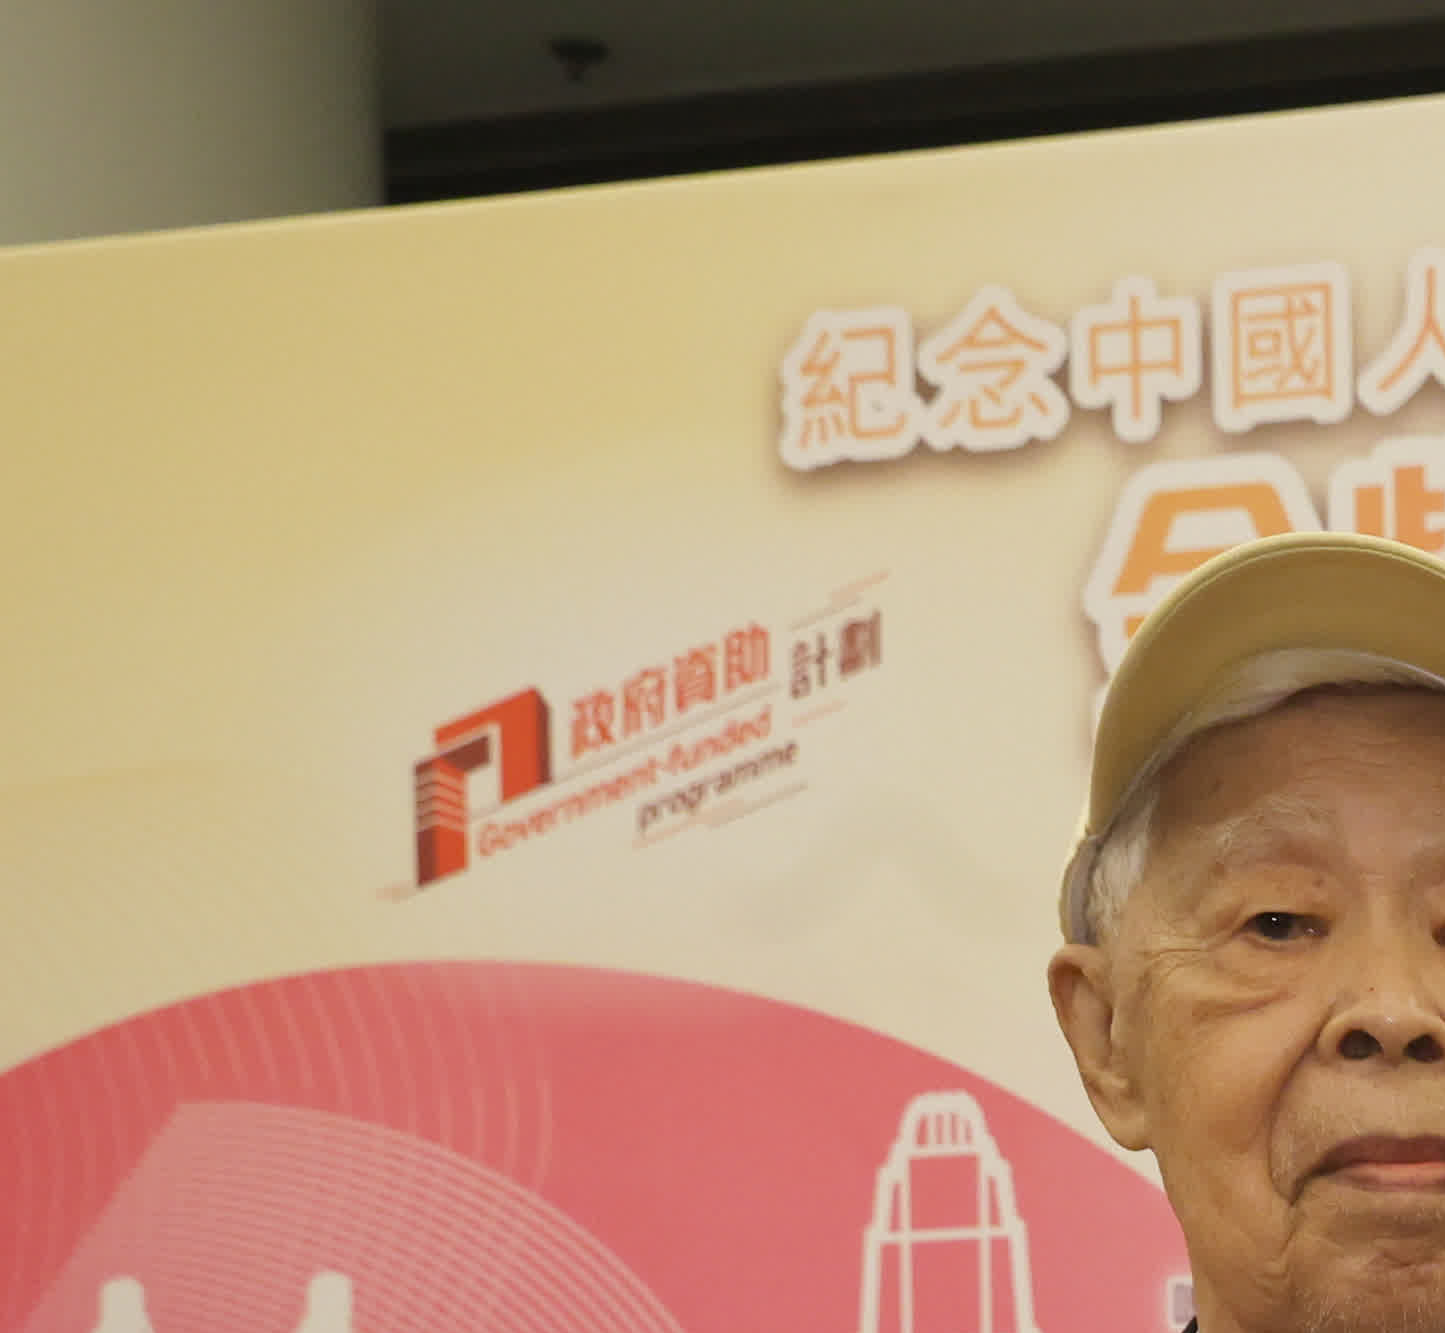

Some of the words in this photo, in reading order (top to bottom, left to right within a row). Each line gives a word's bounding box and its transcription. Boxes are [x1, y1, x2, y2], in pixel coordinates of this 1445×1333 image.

[570, 621, 771, 758] 政府資助
[790, 607, 883, 699] 計劃
[477, 703, 772, 857] Government-funded
[637, 740, 798, 832] programme
